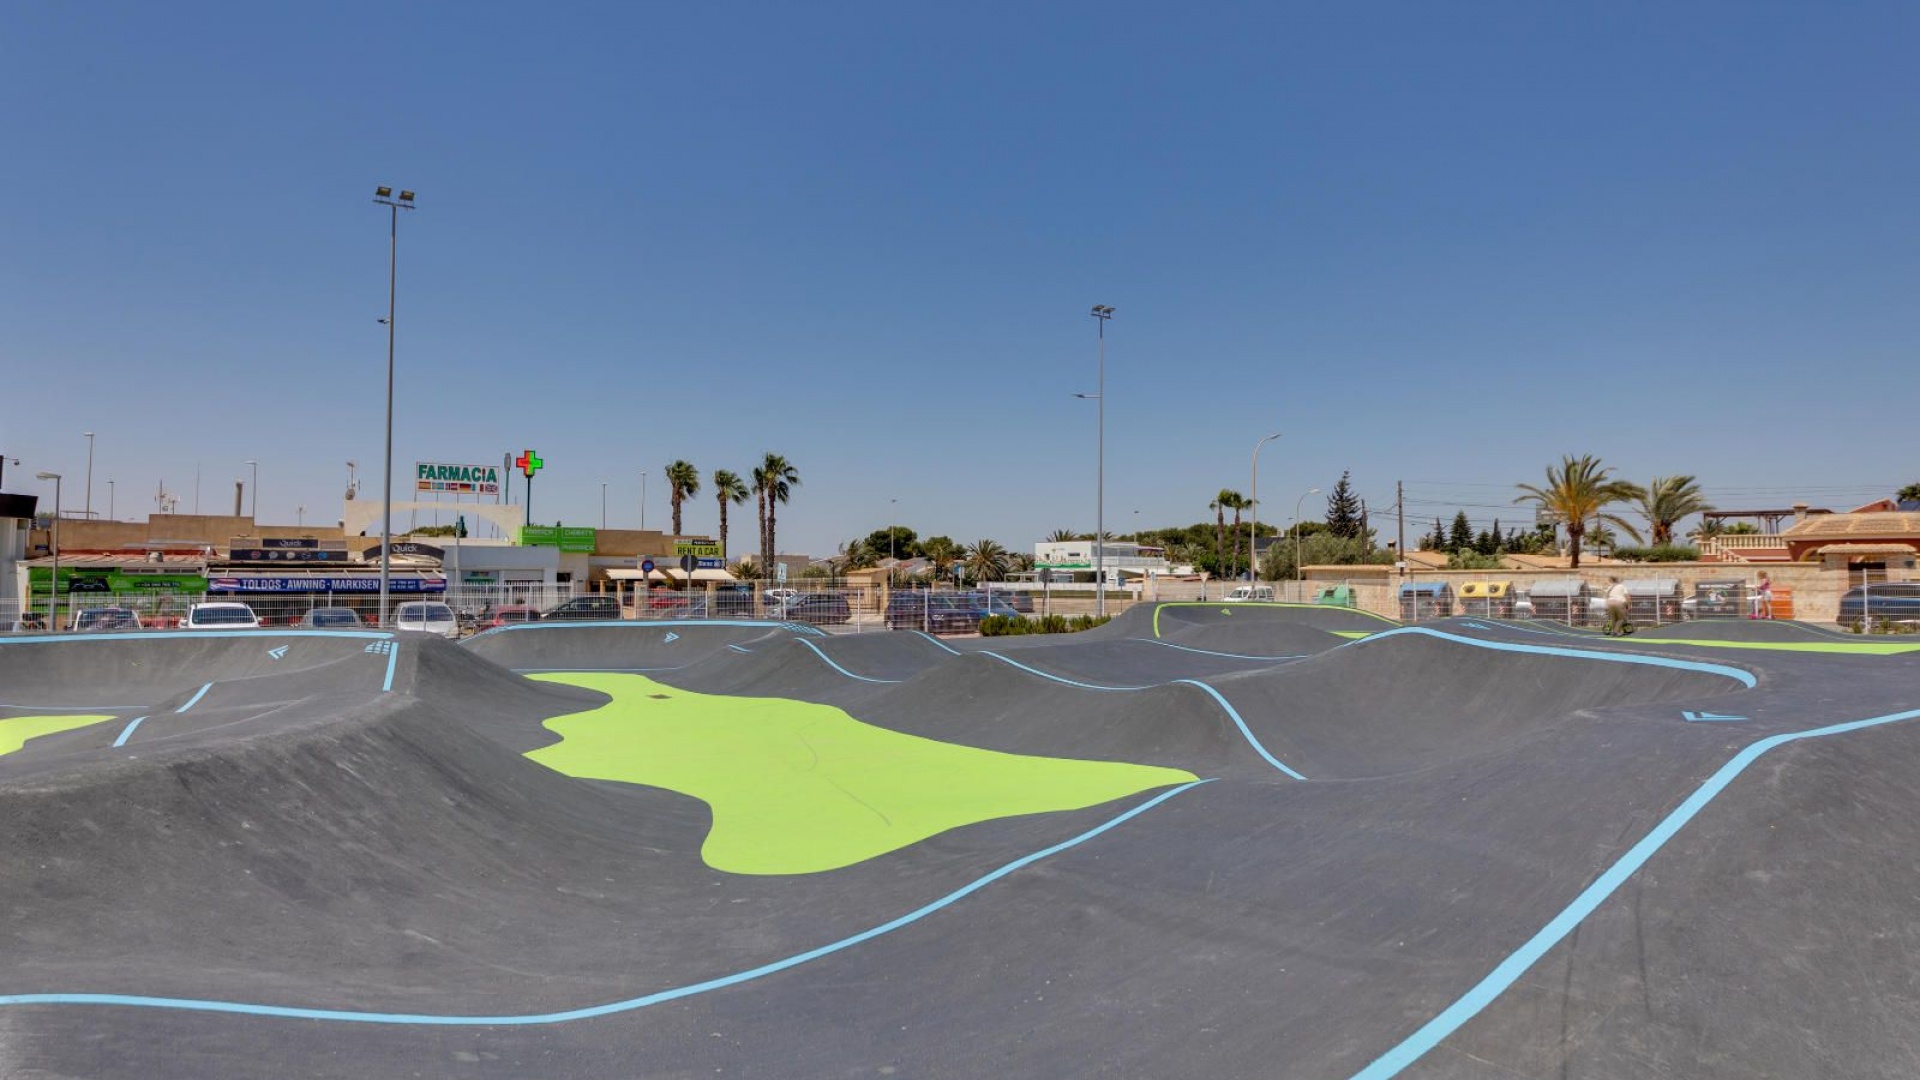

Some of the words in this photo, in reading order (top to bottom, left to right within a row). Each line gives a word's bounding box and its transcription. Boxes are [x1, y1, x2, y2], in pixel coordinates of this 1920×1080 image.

[418, 464, 497, 483] FARMACIA
[279, 539, 302, 548] Quick
[392, 543, 418, 553] Quick
[677, 546, 696, 556] RENT
[704, 547, 719, 556] CAR
[243, 579, 281, 590] TOLDOS
[287, 579, 325, 590] AWNING
[331, 579, 379, 590] MARKISEN
